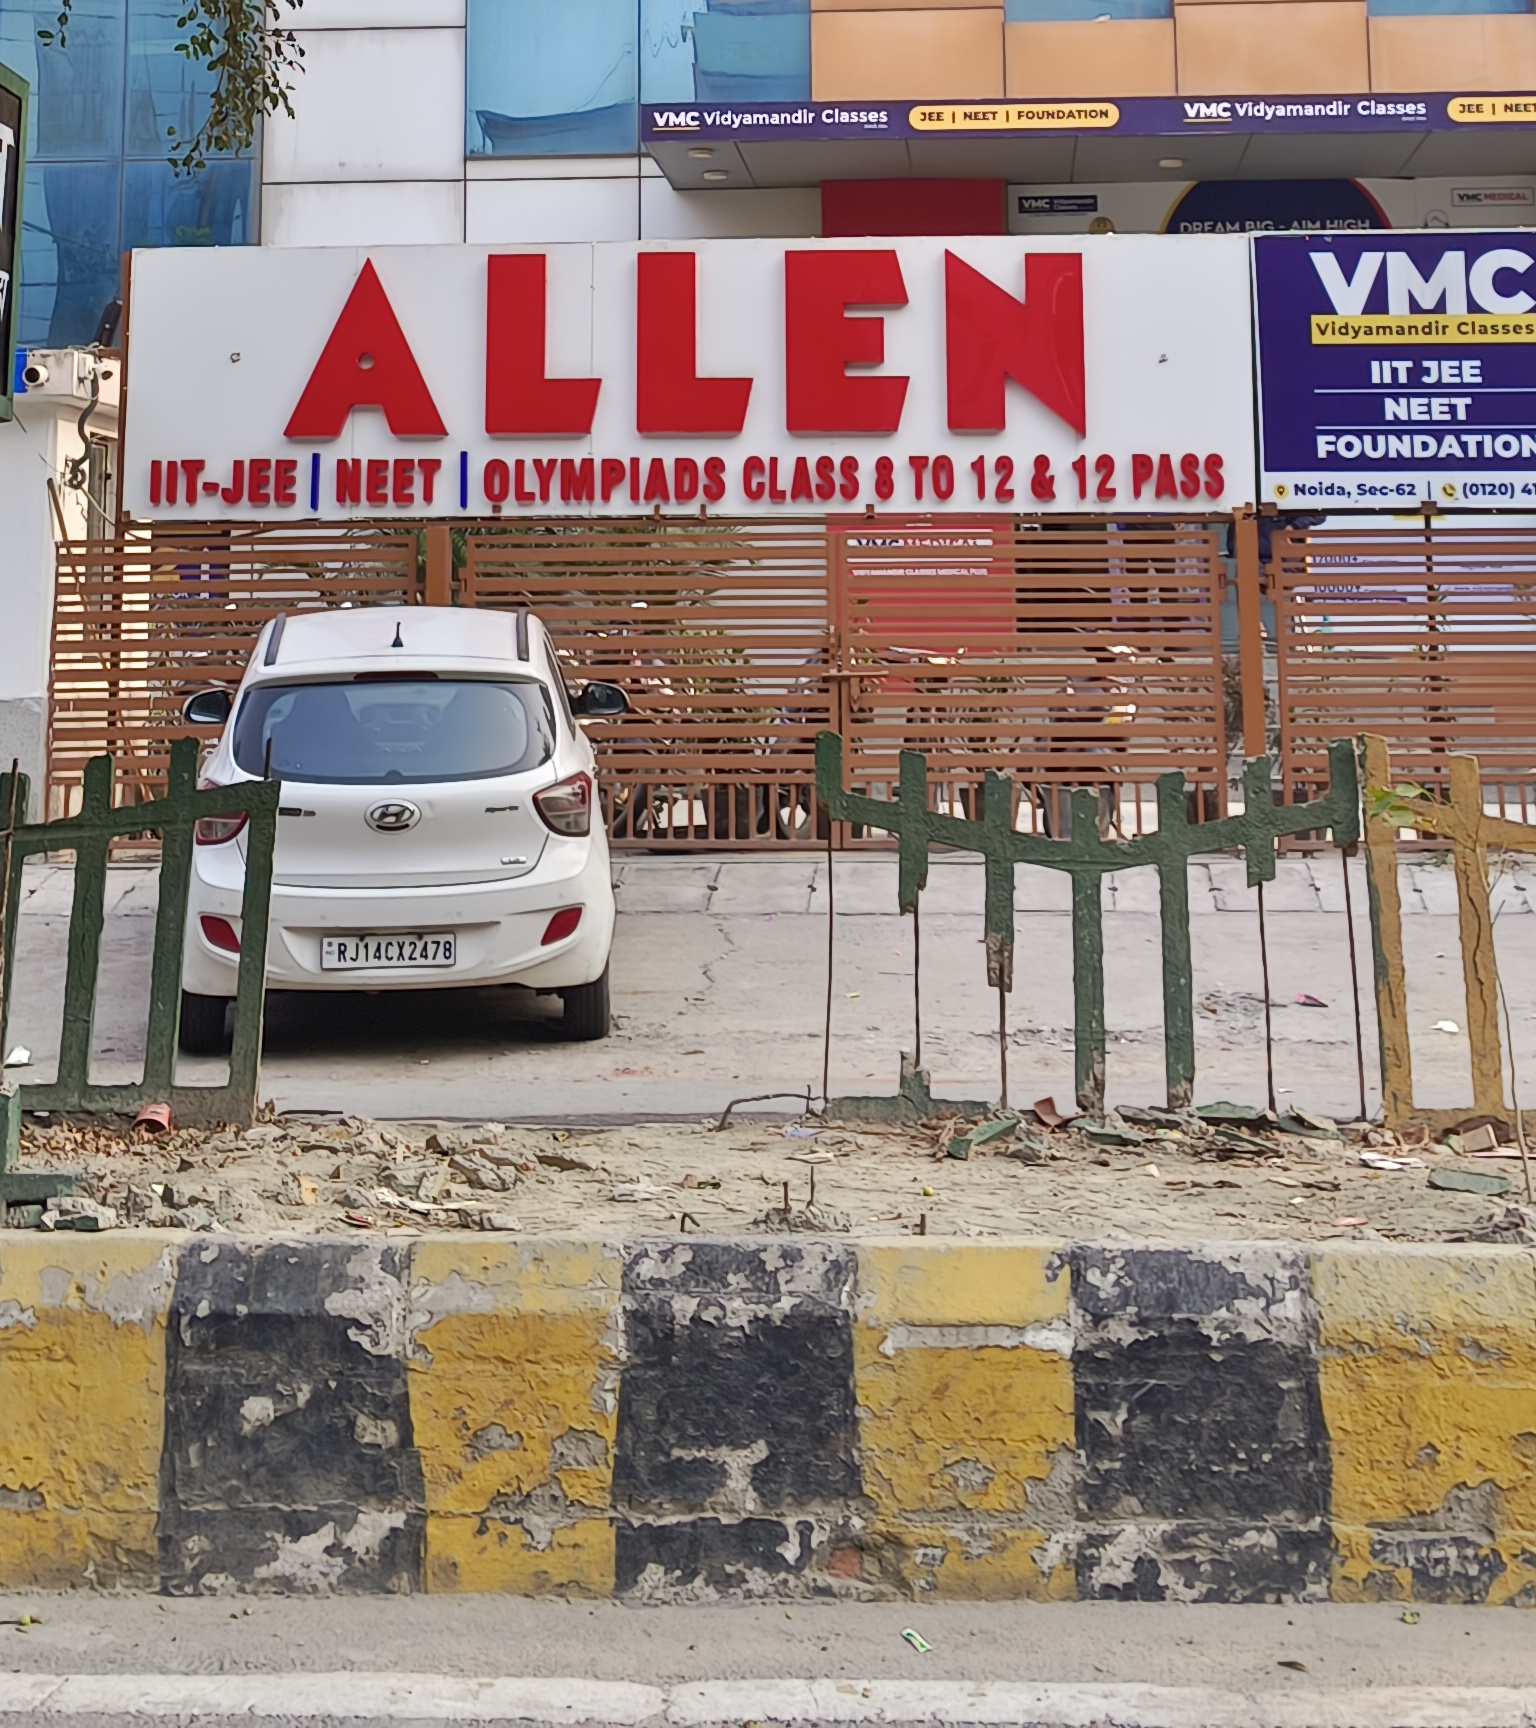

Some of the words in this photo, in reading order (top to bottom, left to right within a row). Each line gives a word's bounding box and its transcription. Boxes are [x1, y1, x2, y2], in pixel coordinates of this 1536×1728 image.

[920, 111, 944, 122] JEE
[964, 111, 998, 121] NEET
[1017, 109, 1109, 120] FOUNDATION
[1184, 102, 1231, 118] VMC
[1235, 101, 1351, 120] Vidyamandir
[1357, 100, 1426, 115] Classes
[1459, 103, 1484, 113] JEE
[653, 111, 700, 126] VMC
[703, 109, 815, 128] Vidyamandir
[822, 109, 888, 123] Classes
[1309, 248, 1536, 316] VMC
[1316, 320, 1449, 340] Vidyamandir
[1457, 320, 1534, 336] Classes
[284, 248, 1086, 439] ALLEN
[1371, 361, 1413, 384] IIT
[1421, 360, 1482, 384] JEE
[1384, 398, 1472, 421] NEET
[149, 458, 298, 506] IIT-JEE
[336, 458, 442, 505] NEET
[483, 456, 726, 504] OLYMPIADS
[743, 455, 860, 503] CLASS
[875, 455, 894, 501] 8
[909, 454, 954, 501] TO
[971, 454, 1015, 502] 12
[1031, 453, 1056, 501] &
[1071, 453, 1117, 501] 12
[1132, 453, 1225, 500] PASS
[1294, 483, 1351, 498] Noida,
[1357, 483, 1417, 497] Sec-62
[1463, 483, 1515, 499] (0120)
[337, 940, 452, 963] RJ14CX2478
